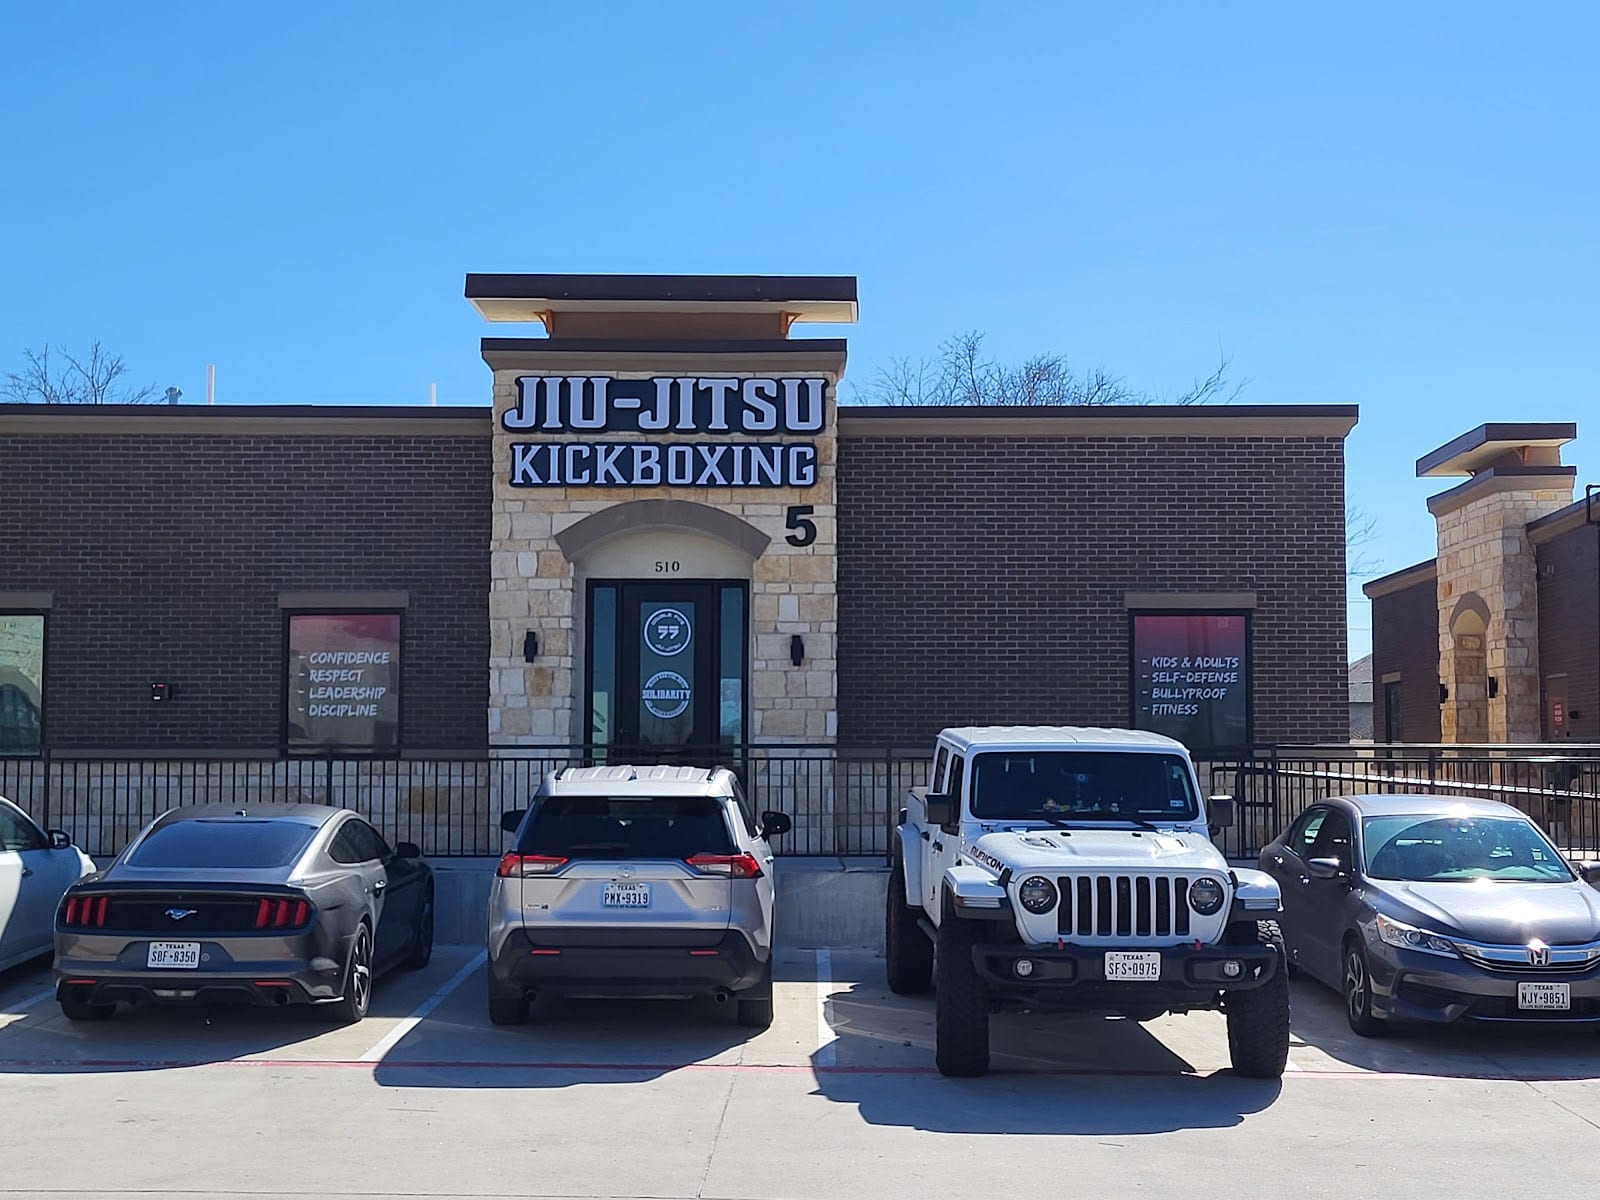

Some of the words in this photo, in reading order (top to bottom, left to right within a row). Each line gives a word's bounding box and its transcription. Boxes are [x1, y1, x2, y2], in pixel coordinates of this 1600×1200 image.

[502, 376, 828, 431] JIU-JITSU
[511, 444, 816, 486] KICKBOXING
[784, 505, 818, 548] 5
[654, 561, 681, 573] 510
[309, 651, 390, 665] CONFIDENCE
[1151, 656, 1178, 669] KIDS
[1181, 657, 1192, 668] &
[1194, 656, 1239, 669] ADULTS
[309, 669, 365, 683] RESPECT
[1151, 671, 1239, 684] SELF-DEFENSE
[309, 686, 387, 700] LEADERSHIP
[1151, 687, 1227, 700] BULLYPROOF
[309, 703, 379, 717] DISCIPLINE
[1151, 703, 1199, 716] FITNESS
[970, 845, 1005, 872] RUBICON
